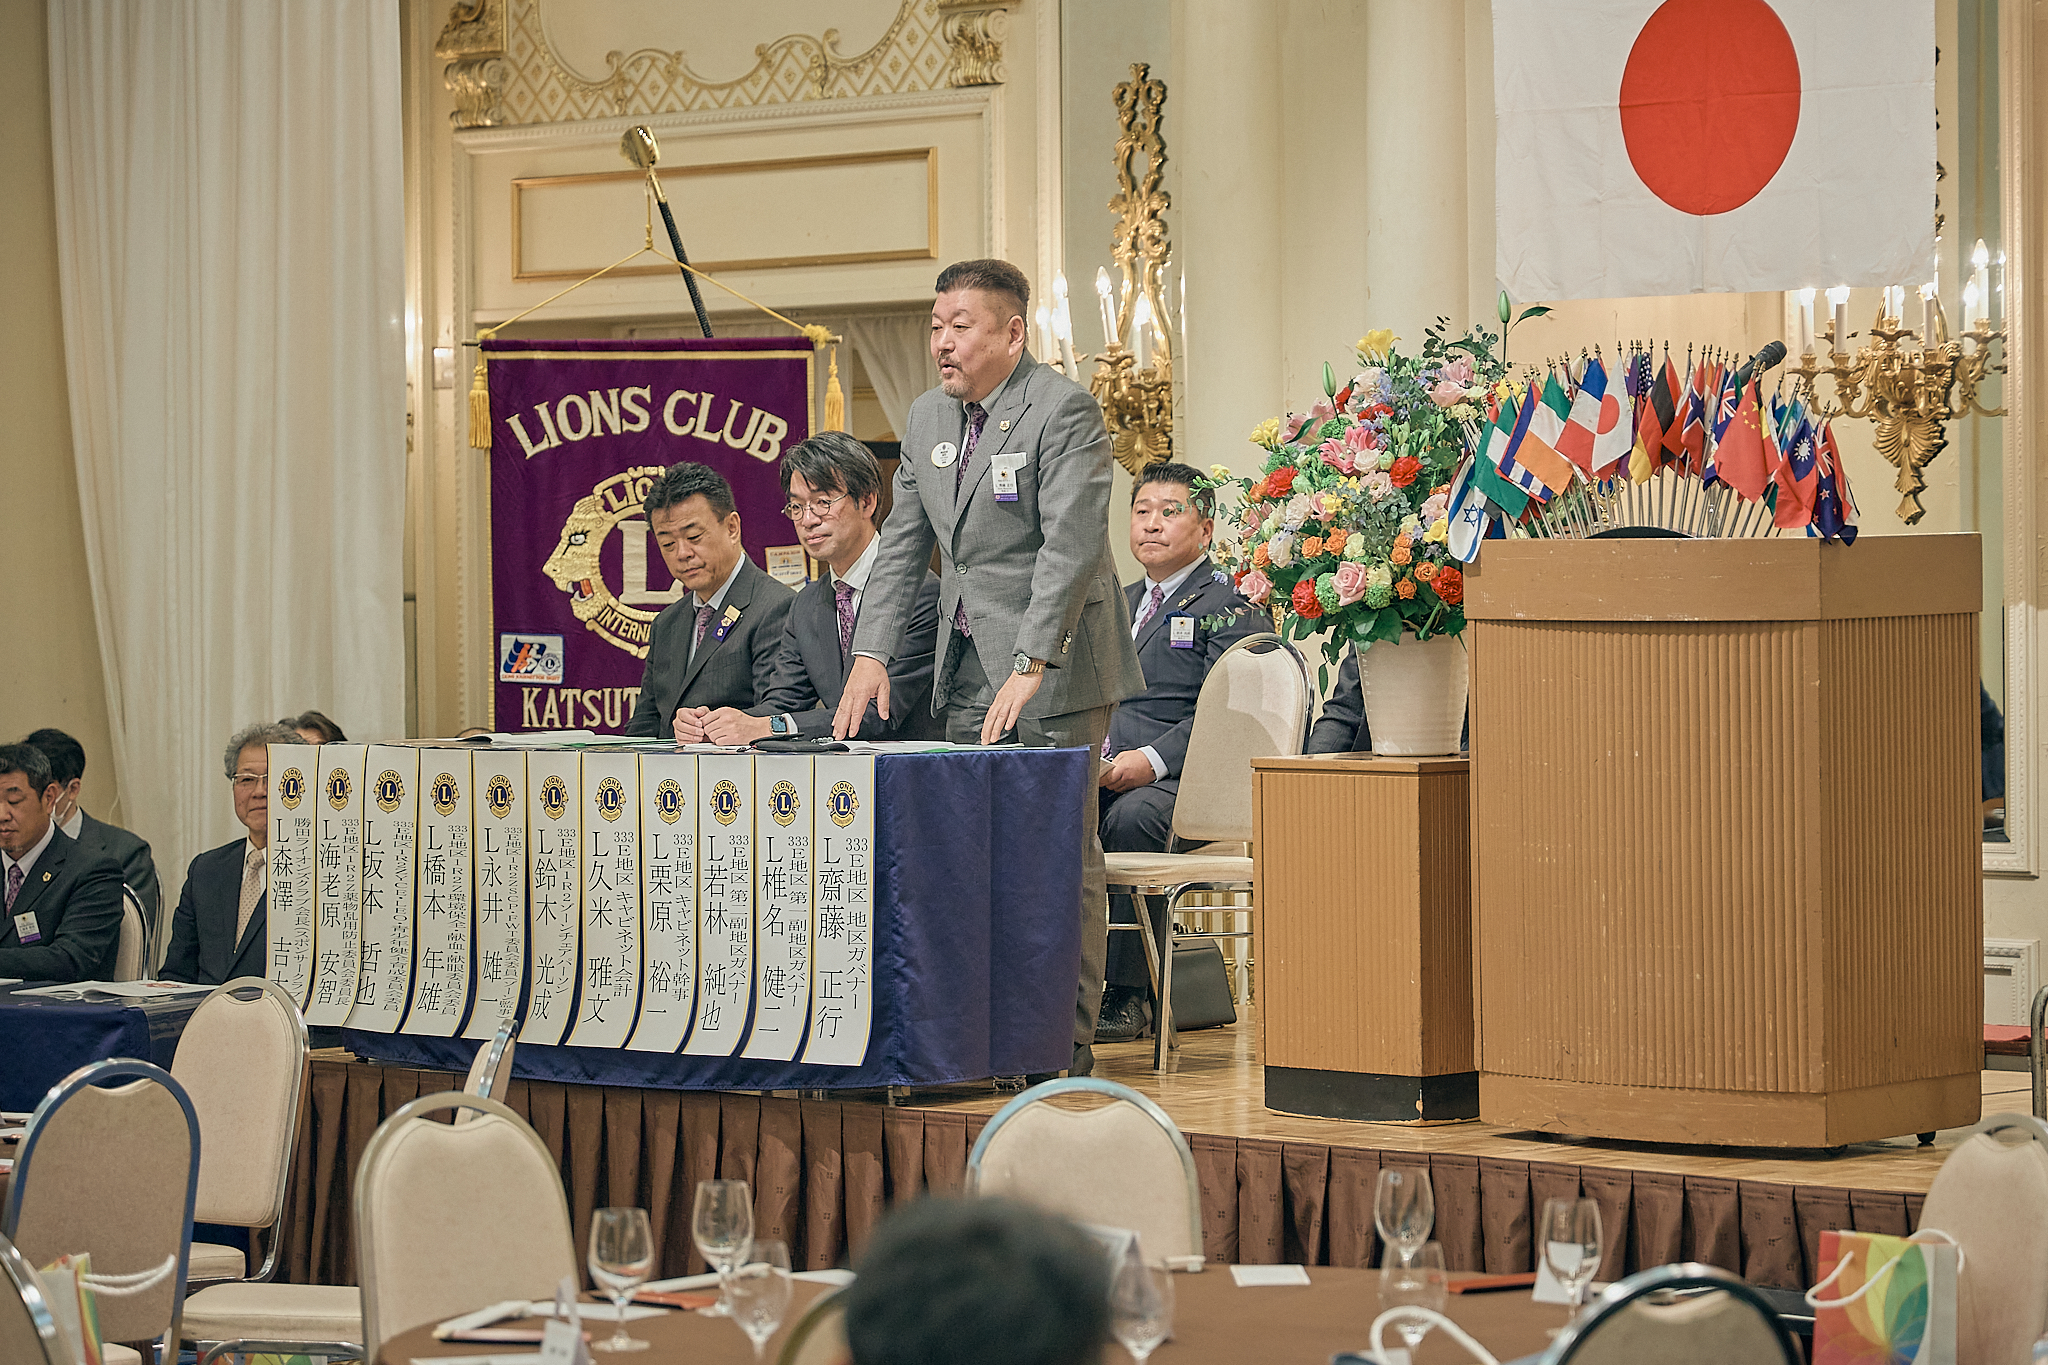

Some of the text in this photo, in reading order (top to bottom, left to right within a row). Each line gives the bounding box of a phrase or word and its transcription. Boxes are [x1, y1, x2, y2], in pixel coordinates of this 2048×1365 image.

[506, 385, 788, 463] LIONS CLUB
[603, 477, 654, 512] LIO
[521, 687, 642, 728] KATSUT
[289, 781, 297, 795] L
[336, 782, 344, 796] L
[386, 783, 395, 798] L
[442, 787, 450, 801] L
[497, 789, 505, 803] L
[551, 790, 560, 804] L
[607, 791, 616, 806] L
[665, 793, 675, 808] L
[721, 794, 731, 810] L
[780, 795, 790, 811] L
[839, 796, 848, 812] L
[272, 818, 294, 912] L森澤
[320, 819, 341, 928] L海老原
[422, 825, 446, 920] L橋本
[481, 828, 503, 924] L永井
[535, 829, 557, 926] L鈴木
[588, 831, 613, 930] L久米
[649, 833, 673, 934] L栗原
[703, 835, 728, 935] L若林
[762, 837, 788, 937] L椎名
[356, 820, 385, 1006] L坂本 哲也
[613, 831, 634, 998] 333E地区 キャビネット会計
[671, 834, 693, 1002] 333E地区 キャビネット幹事
[728, 835, 749, 1004] 333E地区 第二副地区ガバナー
[787, 836, 808, 1007] 333E地区 第一副地区ガバナー
[845, 838, 868, 1010] 333E地区 地区ガバナー
[318, 950, 340, 1005] 安智
[416, 946, 445, 1014] 年雄
[480, 950, 503, 1003] 雄一
[529, 953, 555, 1020] 光成
[582, 956, 613, 1024] 雅文
[646, 960, 671, 1013] 裕一
[701, 963, 728, 1031] 純也
[759, 965, 786, 1033] 健二
[816, 969, 844, 1039] 正行
